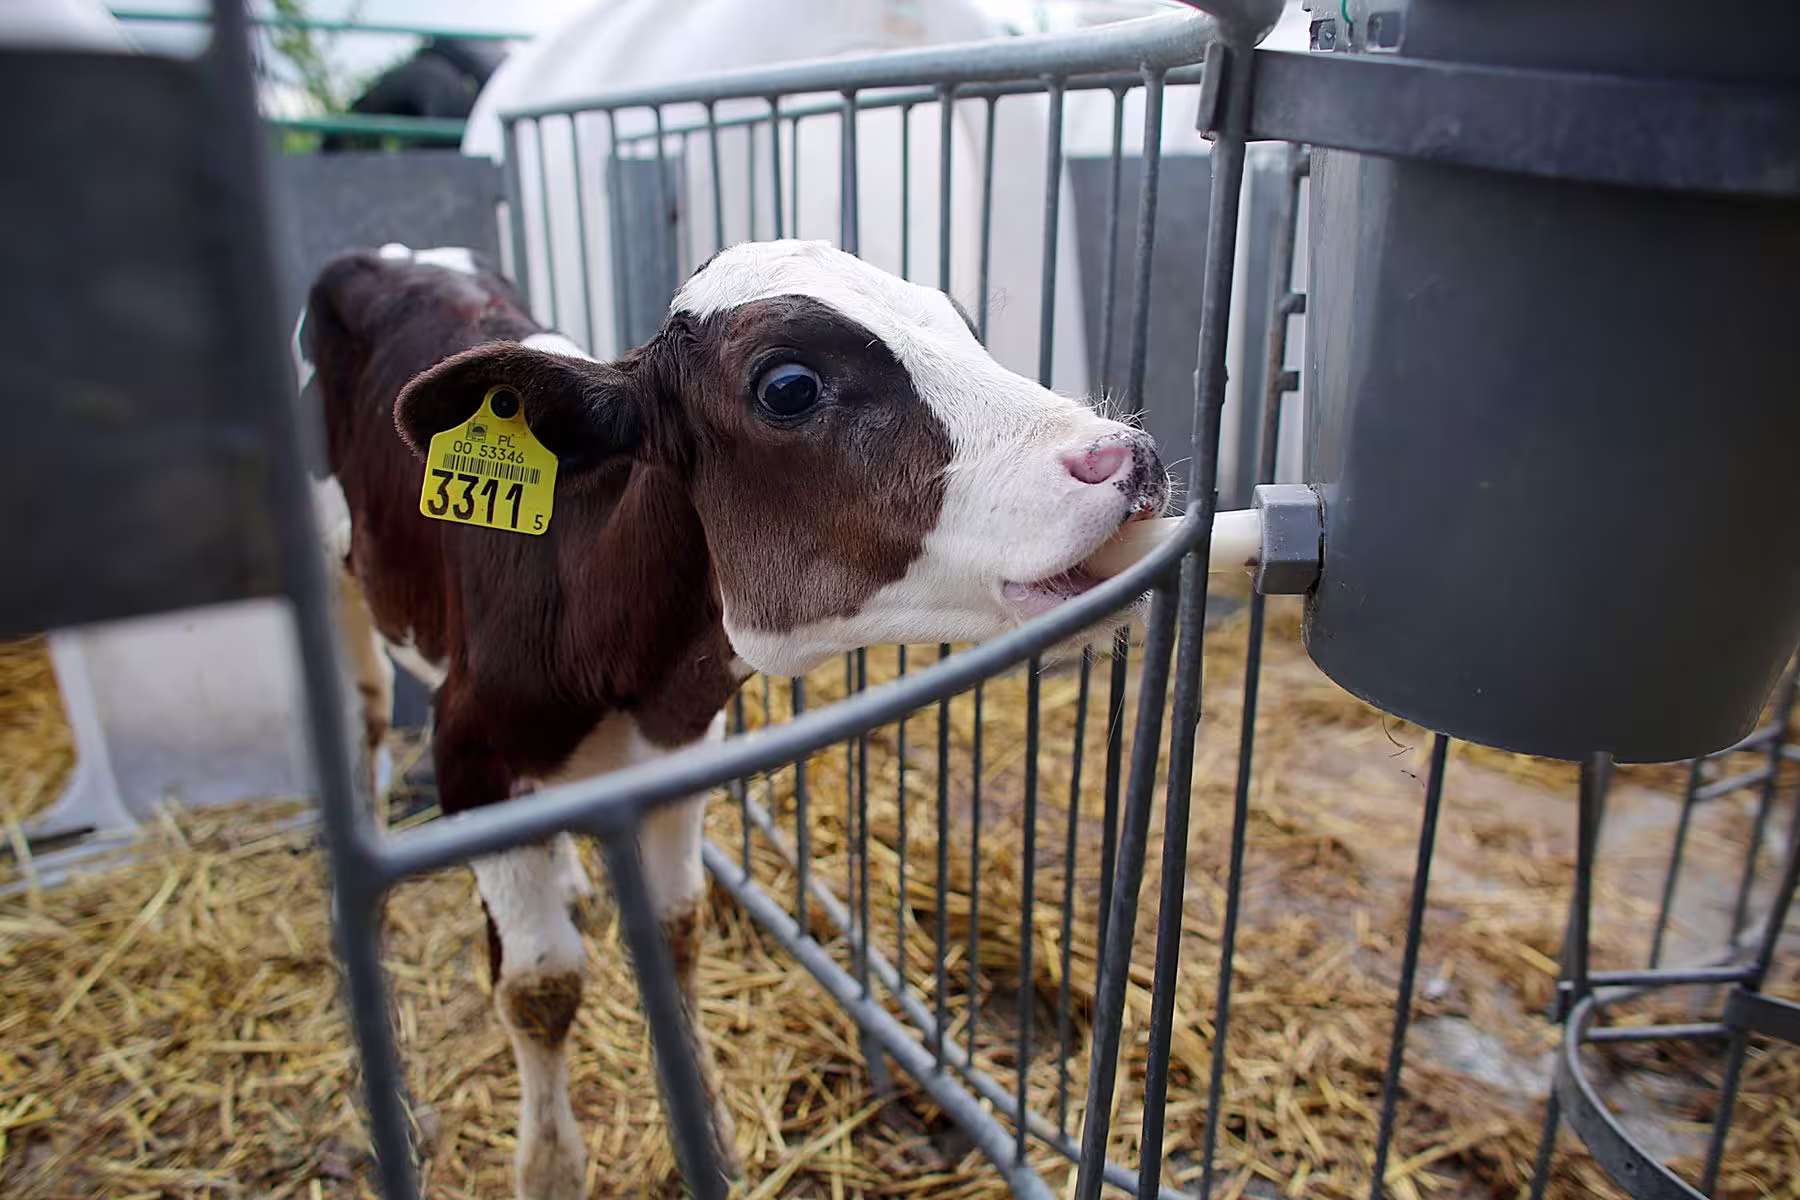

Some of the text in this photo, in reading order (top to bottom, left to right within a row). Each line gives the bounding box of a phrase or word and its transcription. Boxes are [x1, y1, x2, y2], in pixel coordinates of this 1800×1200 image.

[498, 435, 515, 448] PL
[479, 445, 525, 464] 53346
[427, 468, 543, 530] 3311 5
